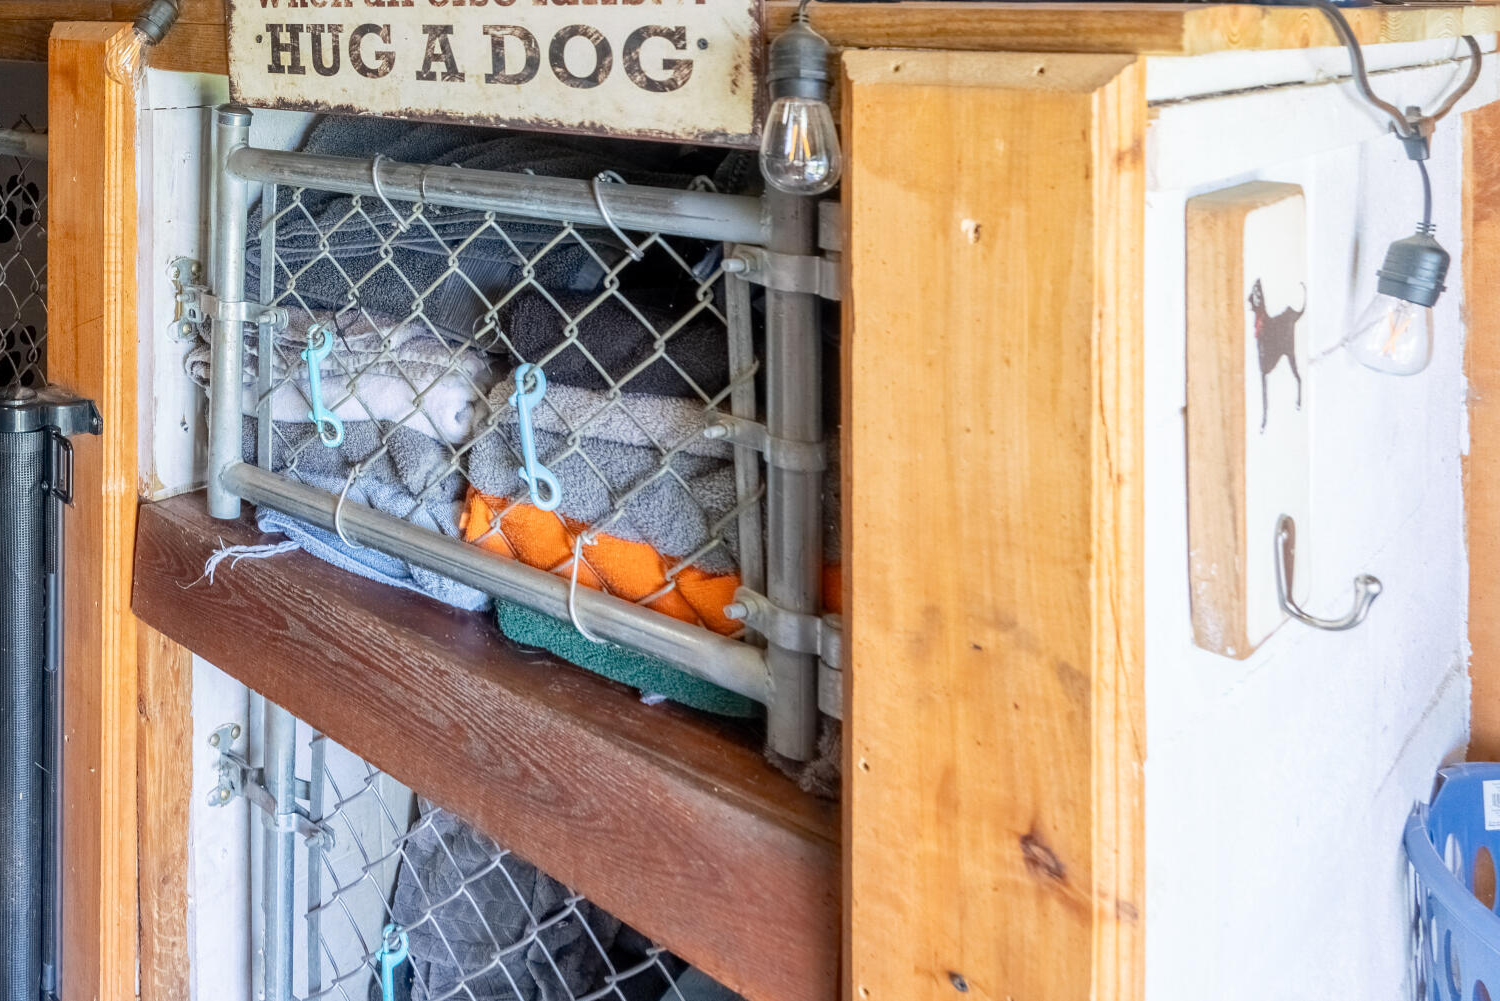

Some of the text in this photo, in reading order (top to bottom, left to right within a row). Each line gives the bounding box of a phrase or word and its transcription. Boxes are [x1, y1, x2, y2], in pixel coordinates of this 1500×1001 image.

[265, 23, 695, 93] HUG A DOG
